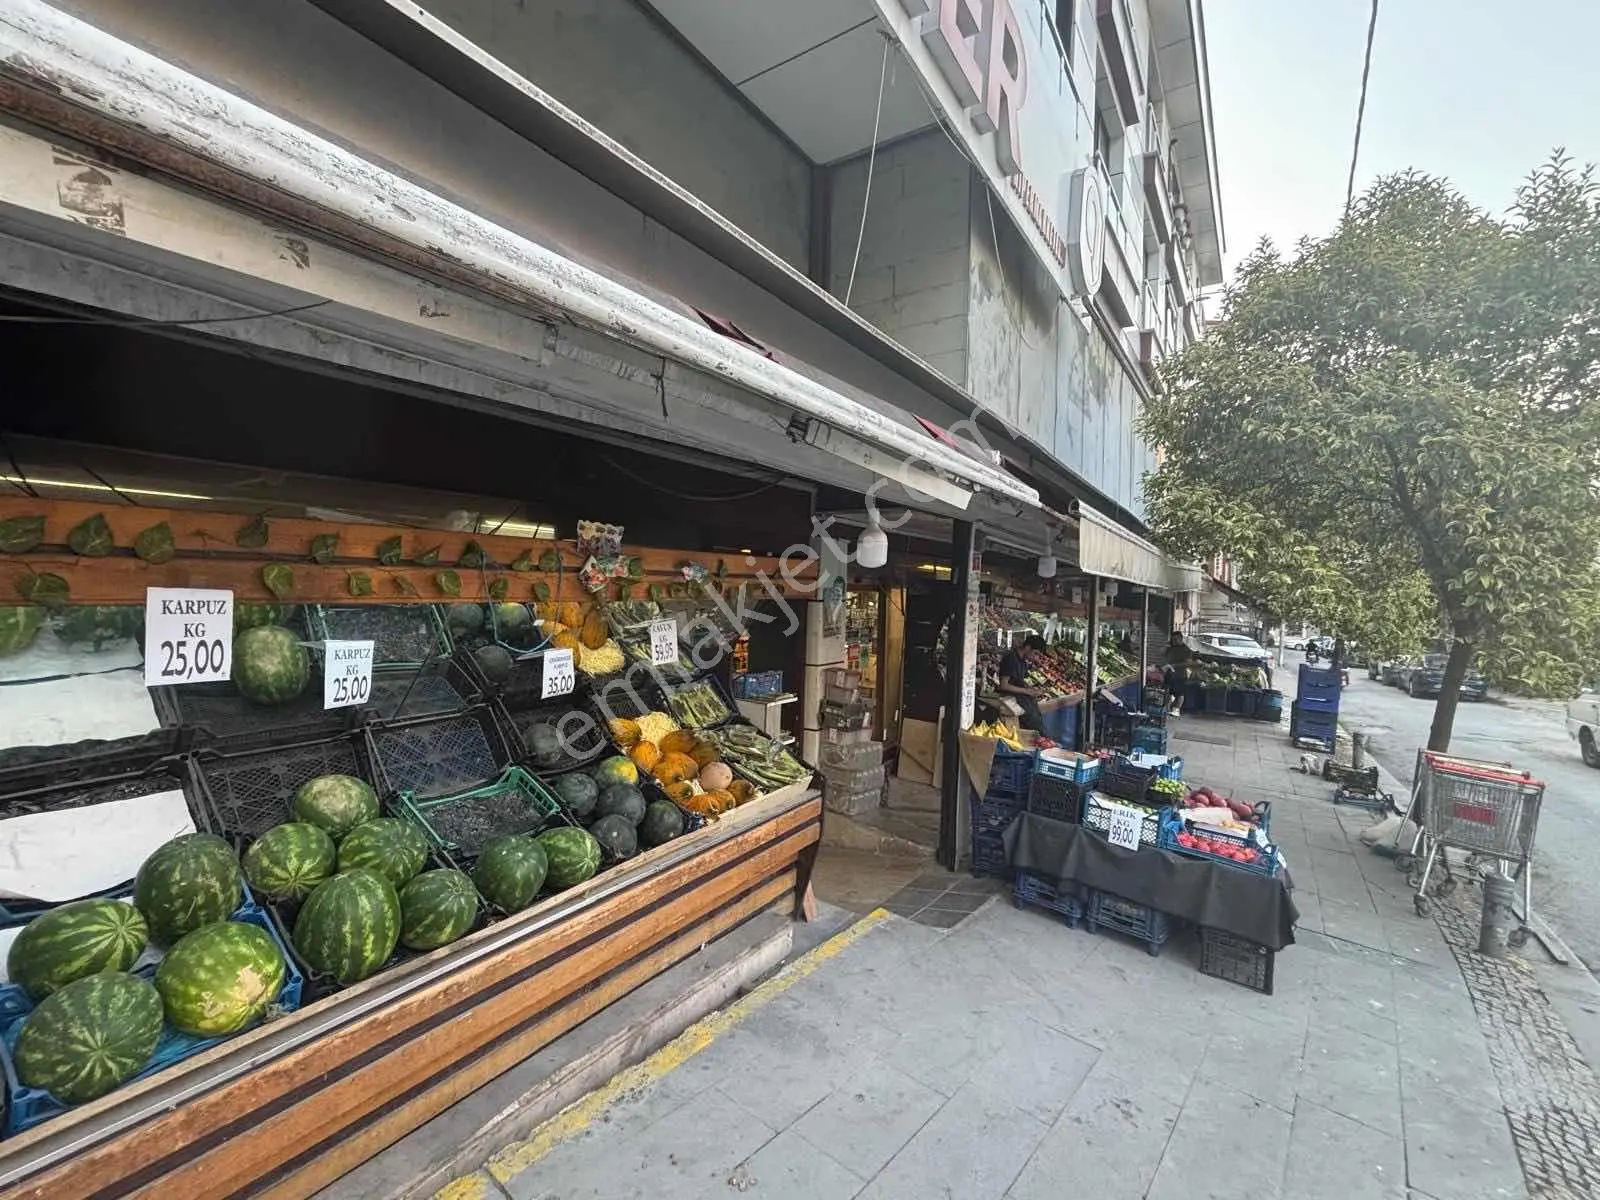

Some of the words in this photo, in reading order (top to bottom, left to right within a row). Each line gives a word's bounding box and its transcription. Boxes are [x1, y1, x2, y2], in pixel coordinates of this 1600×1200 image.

[161, 599, 226, 615] KARPUZ
[183, 622, 206, 638] KG
[161, 639, 225, 680] 25,00
[334, 648, 371, 660] KARPUZ
[345, 664, 359, 676] KG
[333, 675, 368, 704] 25,00
[548, 675, 573, 695] 35,00
[1112, 824, 1134, 844] 99,00
